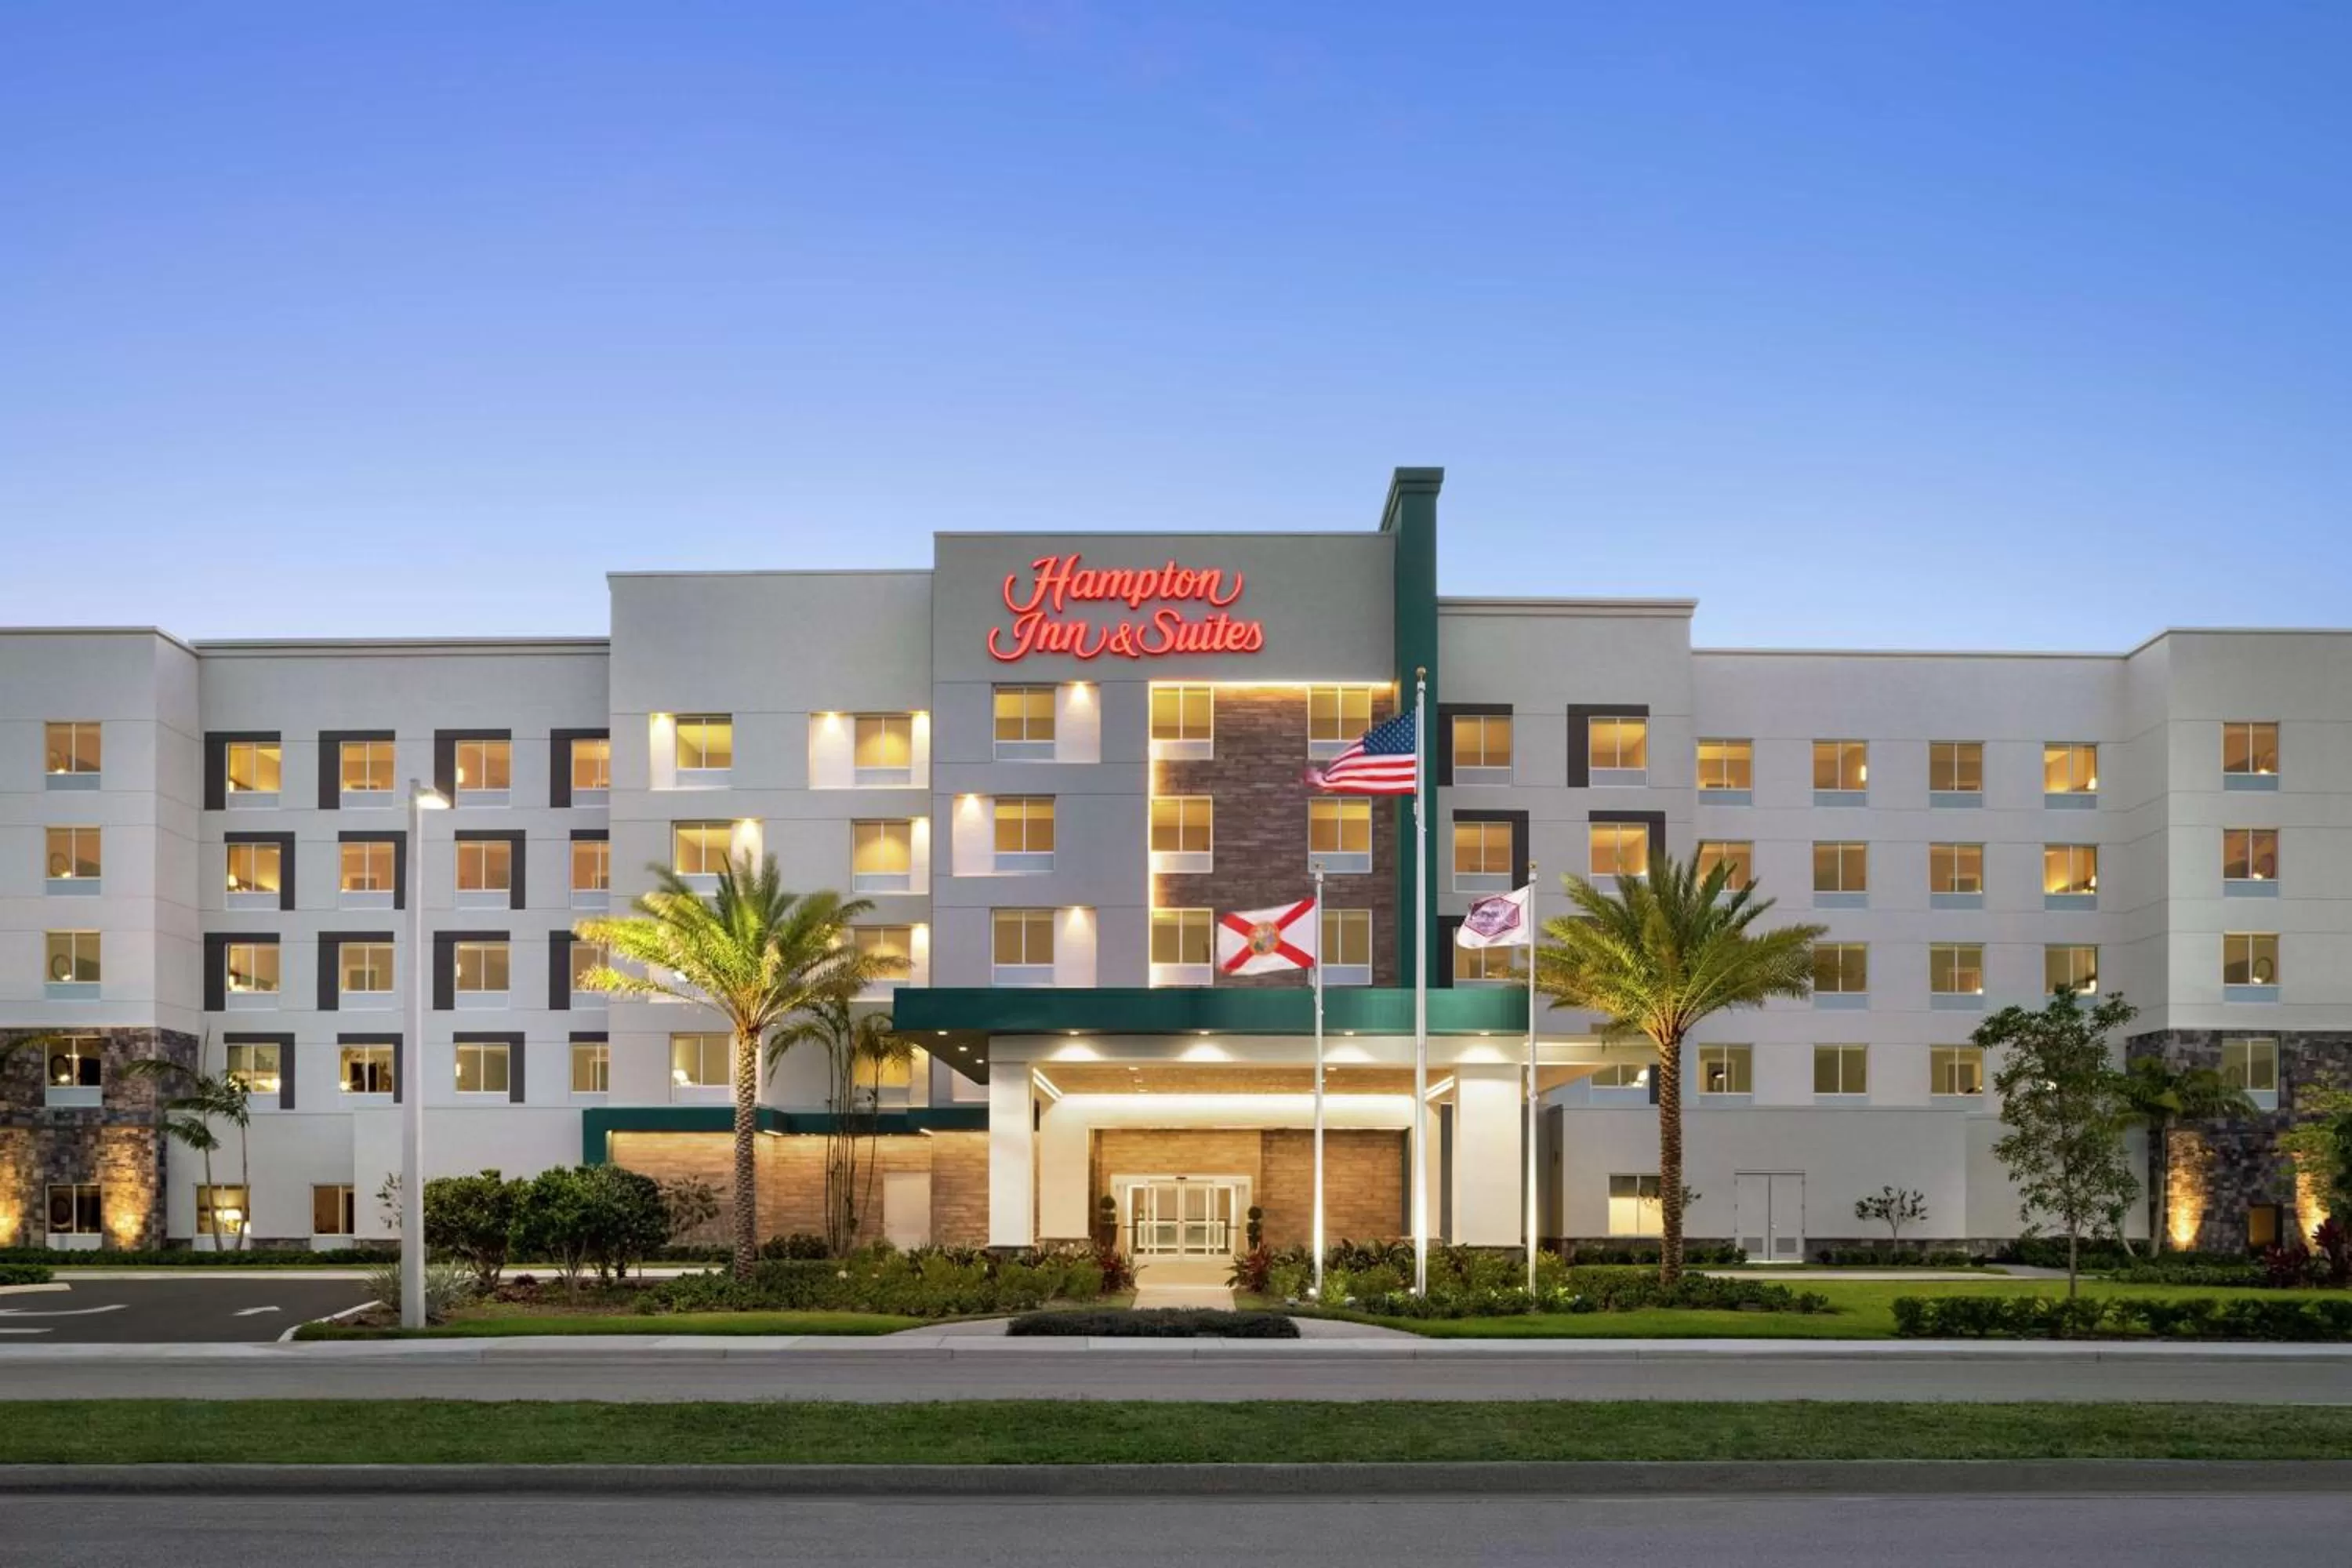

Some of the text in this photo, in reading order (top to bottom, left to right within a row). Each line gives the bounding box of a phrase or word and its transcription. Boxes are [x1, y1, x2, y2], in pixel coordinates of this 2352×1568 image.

[1004, 553, 1243, 613] Hampton
[987, 608, 1264, 660] Inn & Suites
